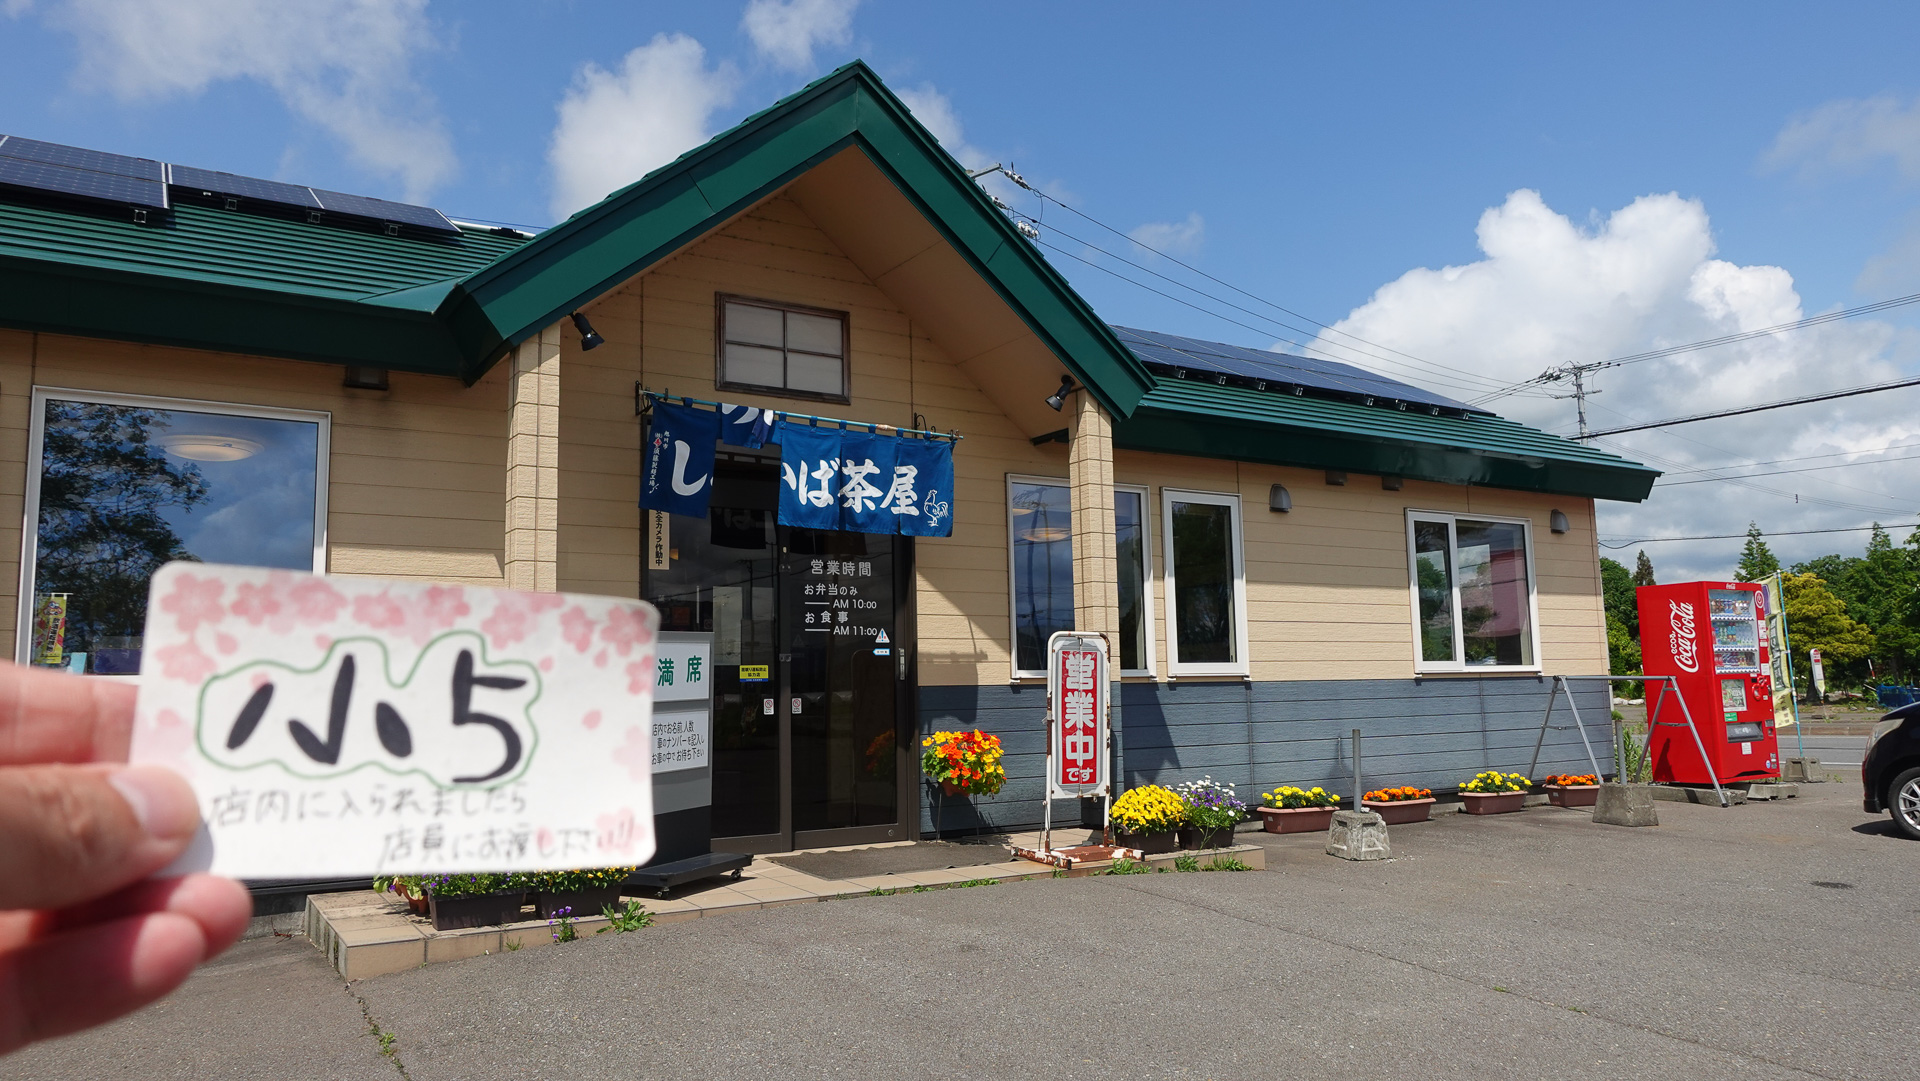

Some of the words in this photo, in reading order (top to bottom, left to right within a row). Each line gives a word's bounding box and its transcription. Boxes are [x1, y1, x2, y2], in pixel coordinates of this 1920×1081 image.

[810, 559, 872, 577] 営業時間
[804, 582, 858, 596] お弁当のみ
[833, 598, 849, 609] AM
[852, 599, 877, 609] 10:00
[804, 610, 849, 624] お食事
[833, 625, 850, 636] AM
[853, 626, 878, 636] 11:00
